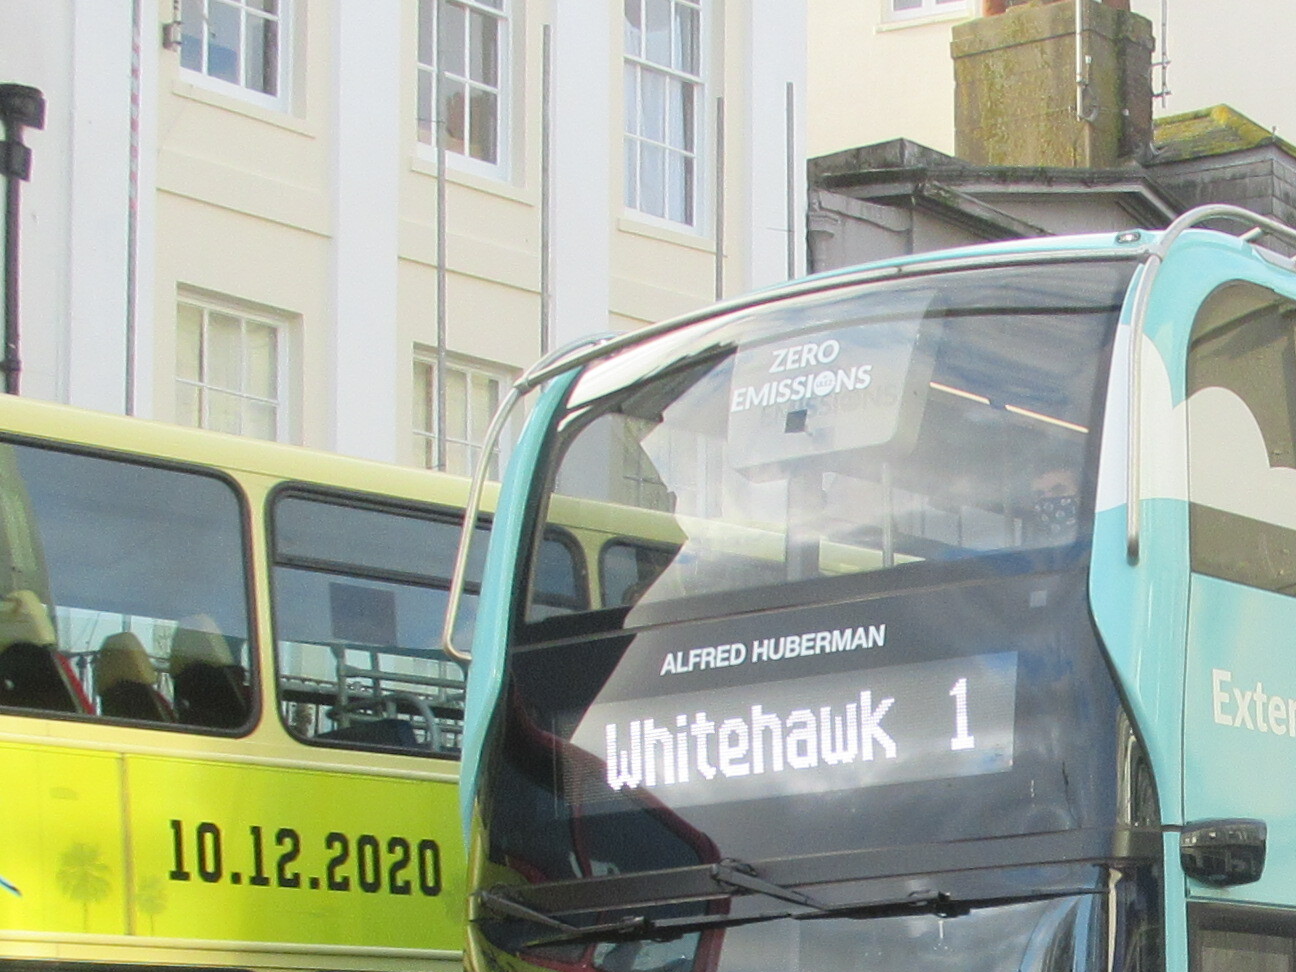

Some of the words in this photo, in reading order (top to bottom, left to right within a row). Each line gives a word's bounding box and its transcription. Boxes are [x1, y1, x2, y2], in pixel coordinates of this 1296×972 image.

[768, 339, 840, 374] ZERO
[730, 364, 873, 413] EMISSIONS
[660, 643, 747, 677] ALFRED
[751, 624, 886, 664] HUBERMAN
[604, 690, 898, 792] Whitehawk
[949, 678, 976, 752] 1
[168, 819, 442, 898] 10.12.2020
